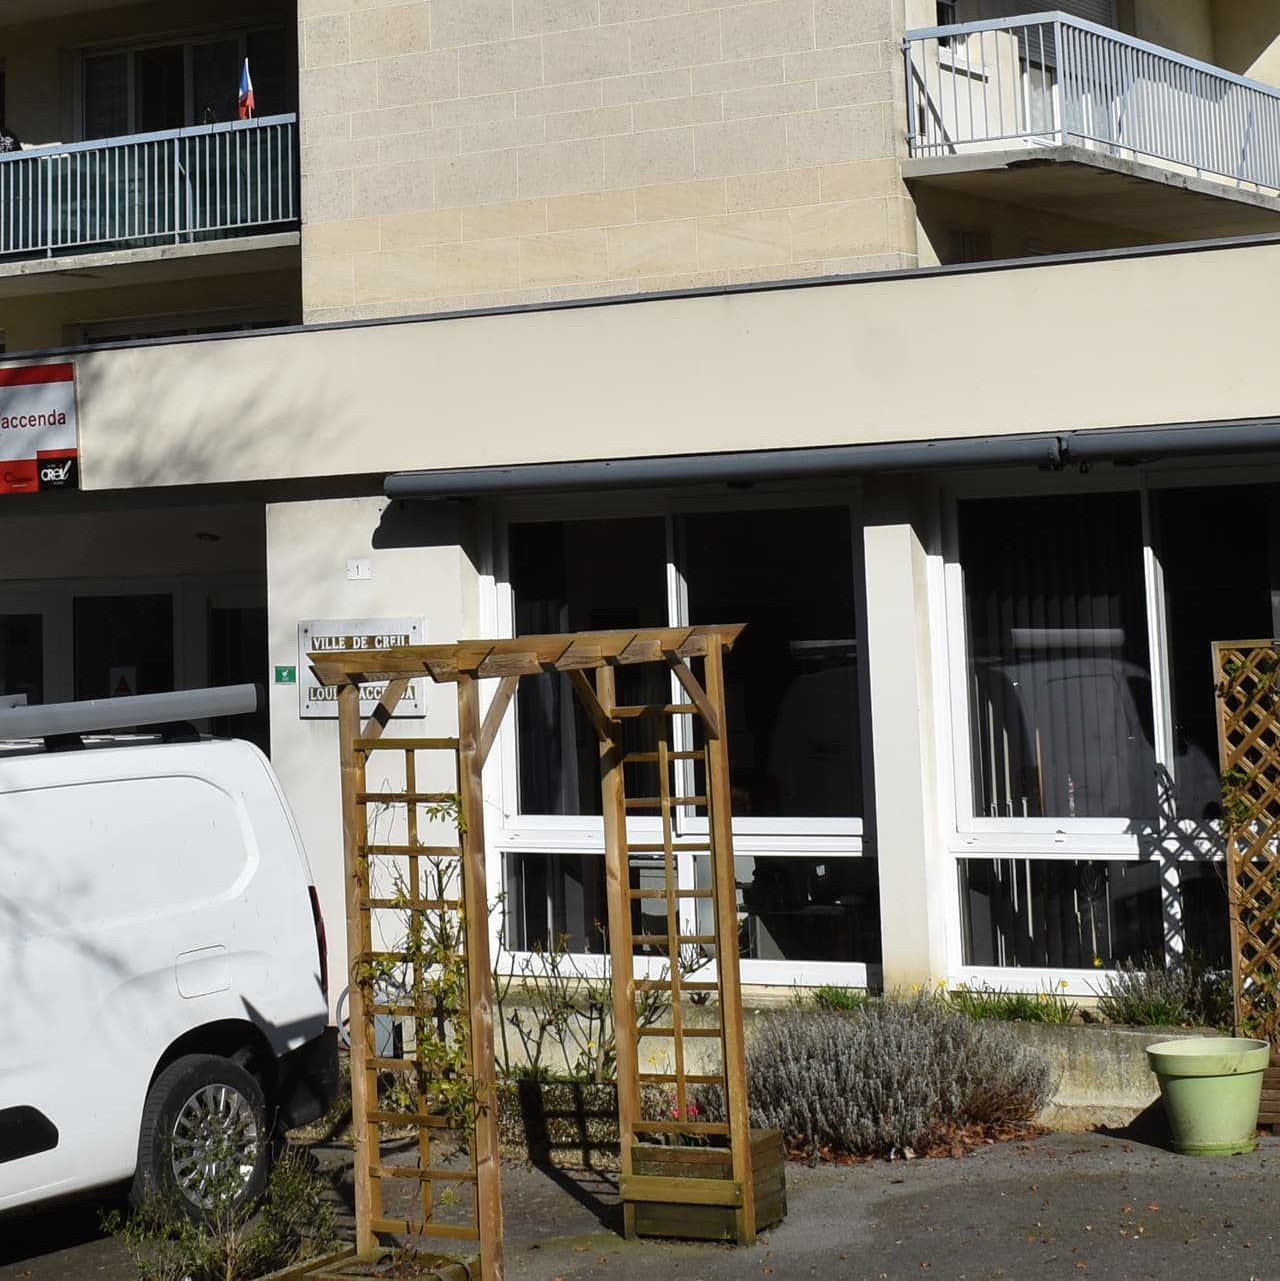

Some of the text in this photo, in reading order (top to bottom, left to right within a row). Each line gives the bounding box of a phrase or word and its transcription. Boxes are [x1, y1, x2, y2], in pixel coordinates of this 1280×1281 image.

[313, 635, 409, 649] VILLE DE CREIL
[310, 687, 338, 700] LOUI
